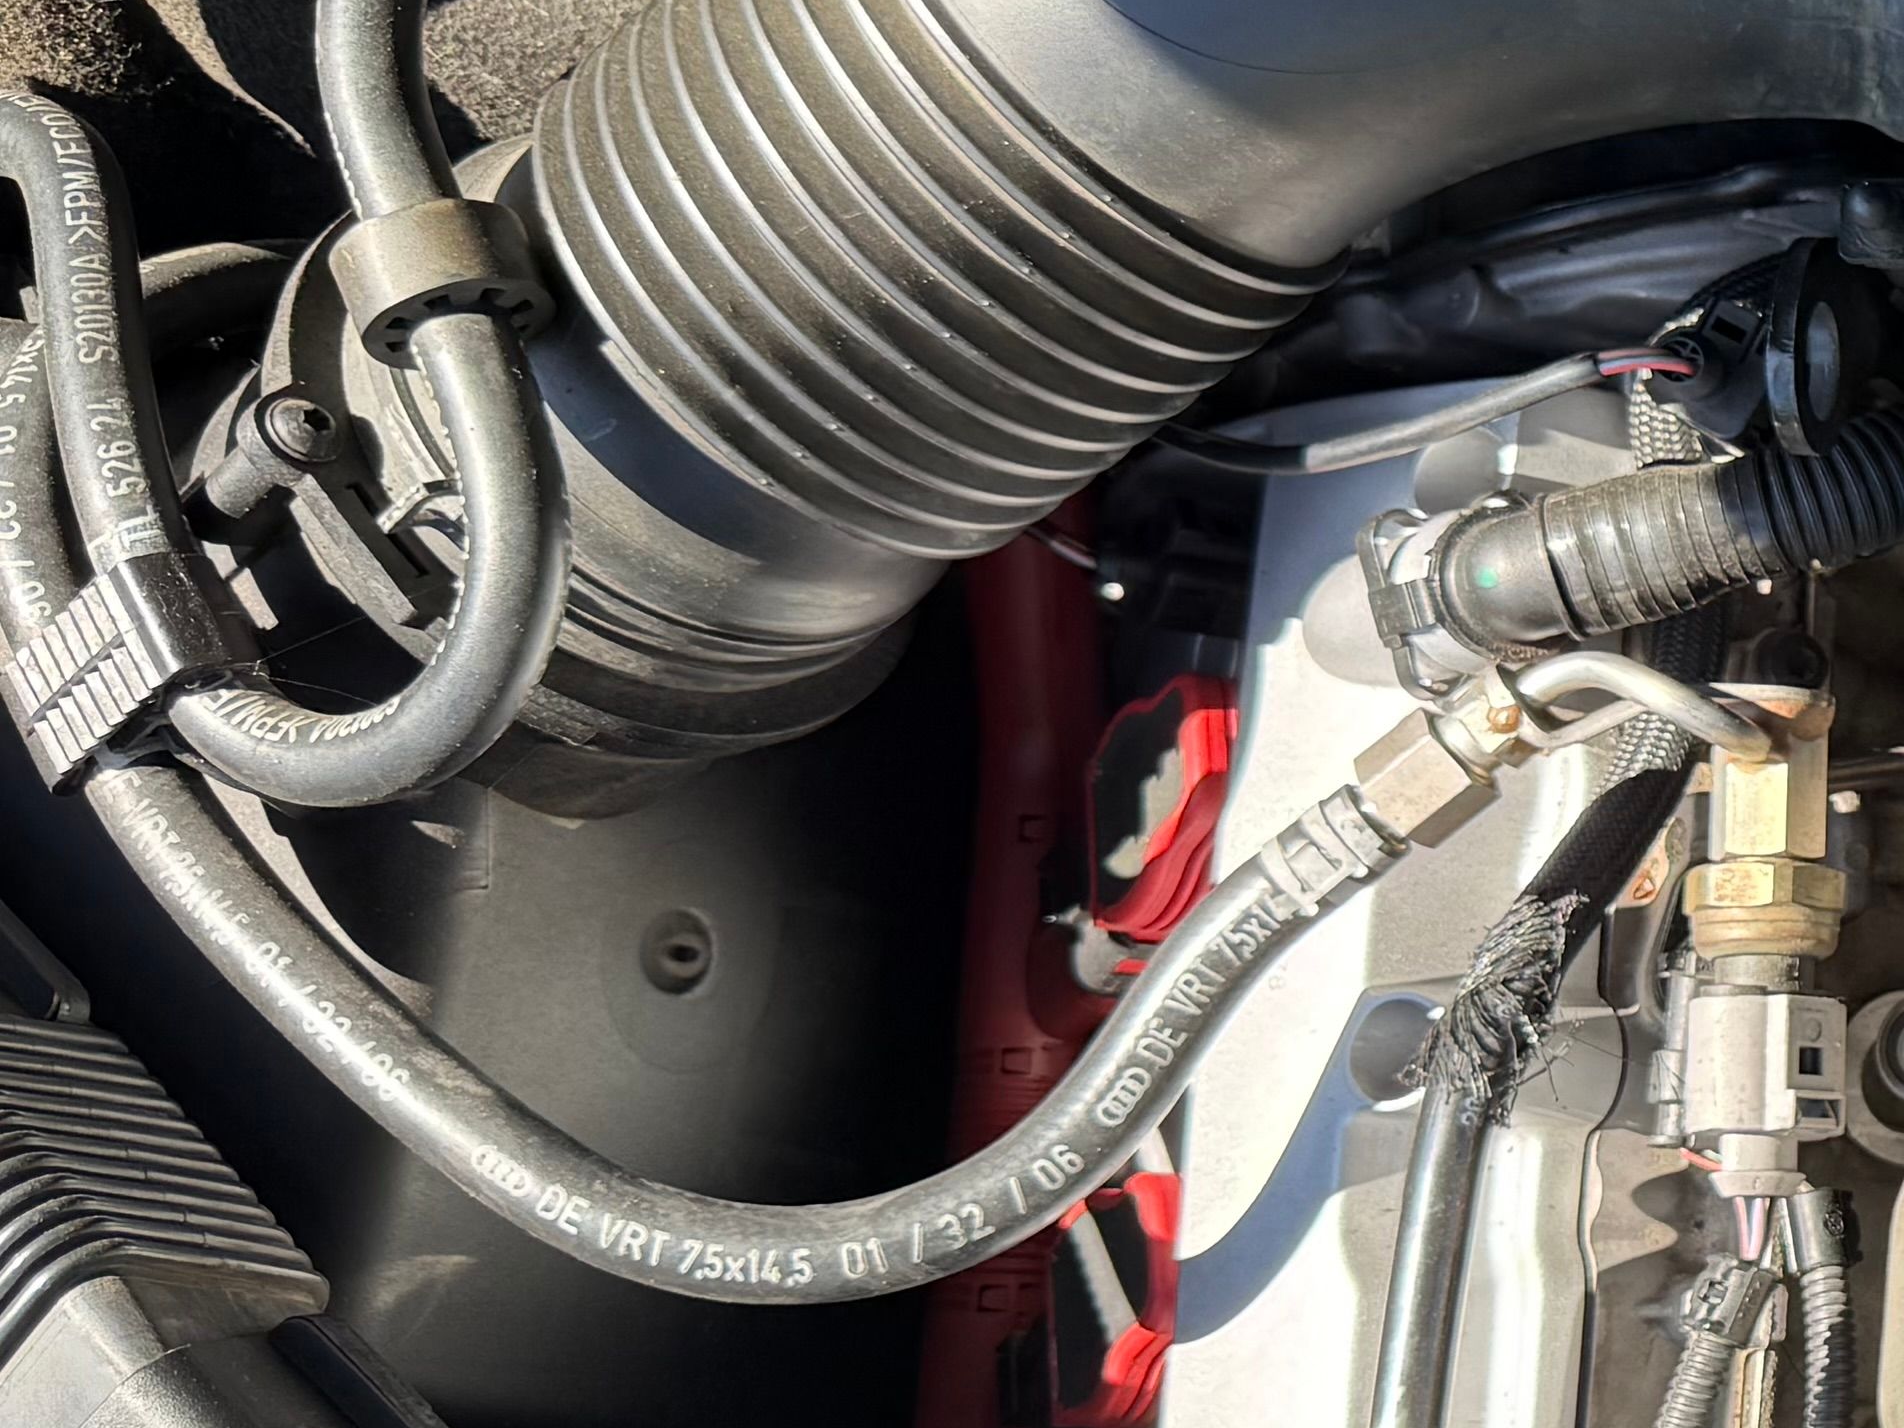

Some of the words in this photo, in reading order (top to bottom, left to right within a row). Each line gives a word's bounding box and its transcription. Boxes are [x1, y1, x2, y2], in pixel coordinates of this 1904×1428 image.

[70, 251, 120, 365] S20130A
[98, 439, 148, 500] 526
[1135, 1016, 1189, 1070] DE
[1162, 955, 1228, 1015] VRT
[534, 1180, 592, 1236] DE
[598, 1211, 673, 1269] VRT
[839, 1236, 891, 1278] 01
[936, 1201, 998, 1252] 32
[1032, 1142, 1087, 1193] 06
